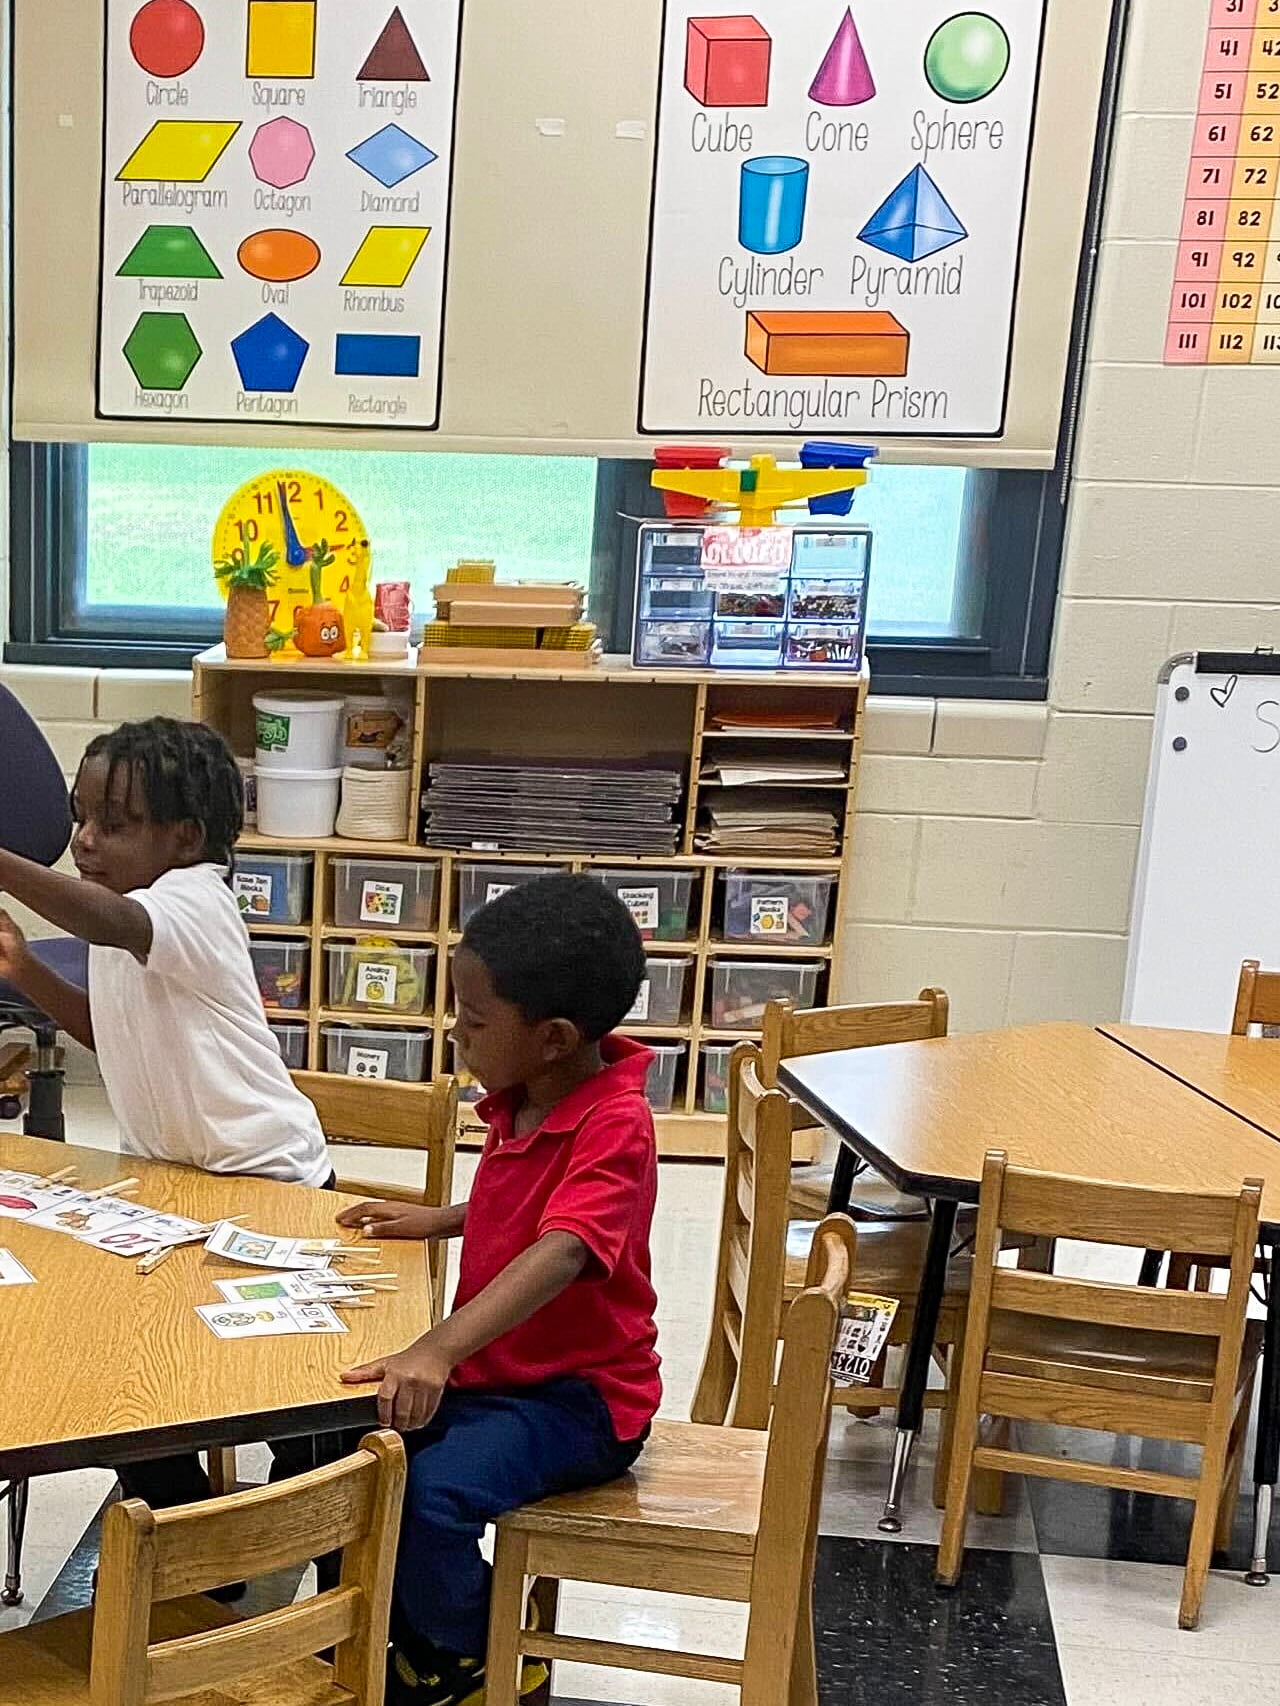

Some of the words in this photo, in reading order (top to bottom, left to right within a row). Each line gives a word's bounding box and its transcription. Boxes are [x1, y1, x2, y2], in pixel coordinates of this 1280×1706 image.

[1220, 40, 1239, 57] 41
[145, 81, 189, 106] Circle
[252, 81, 306, 114] Square
[357, 84, 418, 116] Triangle
[1213, 83, 1233, 99] 51
[1256, 83, 1280, 99] 52
[690, 112, 753, 152] Cube
[805, 111, 869, 152] Cone
[911, 109, 1004, 164] Sphere
[1207, 126, 1227, 142] 61
[1250, 126, 1274, 142] 62
[1202, 168, 1220, 184] 71
[1244, 168, 1268, 184] 72
[122, 182, 228, 214] Parallelogram
[253, 190, 312, 218] Octagon
[360, 190, 420, 214] Diamond
[1196, 210, 1214, 226] 81
[1238, 210, 1261, 226] 82
[1190, 252, 1208, 267] 91
[1232, 252, 1256, 267] 92
[139, 279, 199, 307] Trapezoid
[718, 256, 824, 308] Cylinder
[850, 255, 964, 308] Pyramid
[261, 284, 289, 305] Oval
[343, 290, 405, 314] Rhombus
[1180, 293, 1207, 309] 101
[1221, 293, 1253, 309] 102
[1265, 293, 1280, 309] 10
[1178, 334, 1198, 349] 111
[1219, 334, 1244, 350] 112
[134, 387, 189, 412] Hexagon
[236, 392, 298, 419] Pentagon
[348, 394, 408, 419] Rectangle
[697, 378, 860, 430] Rectangular
[870, 379, 948, 419] Prism
[252, 491, 273, 514] 11
[314, 489, 324, 511] 1
[233, 519, 259, 542] 10
[334, 510, 349, 533] 2
